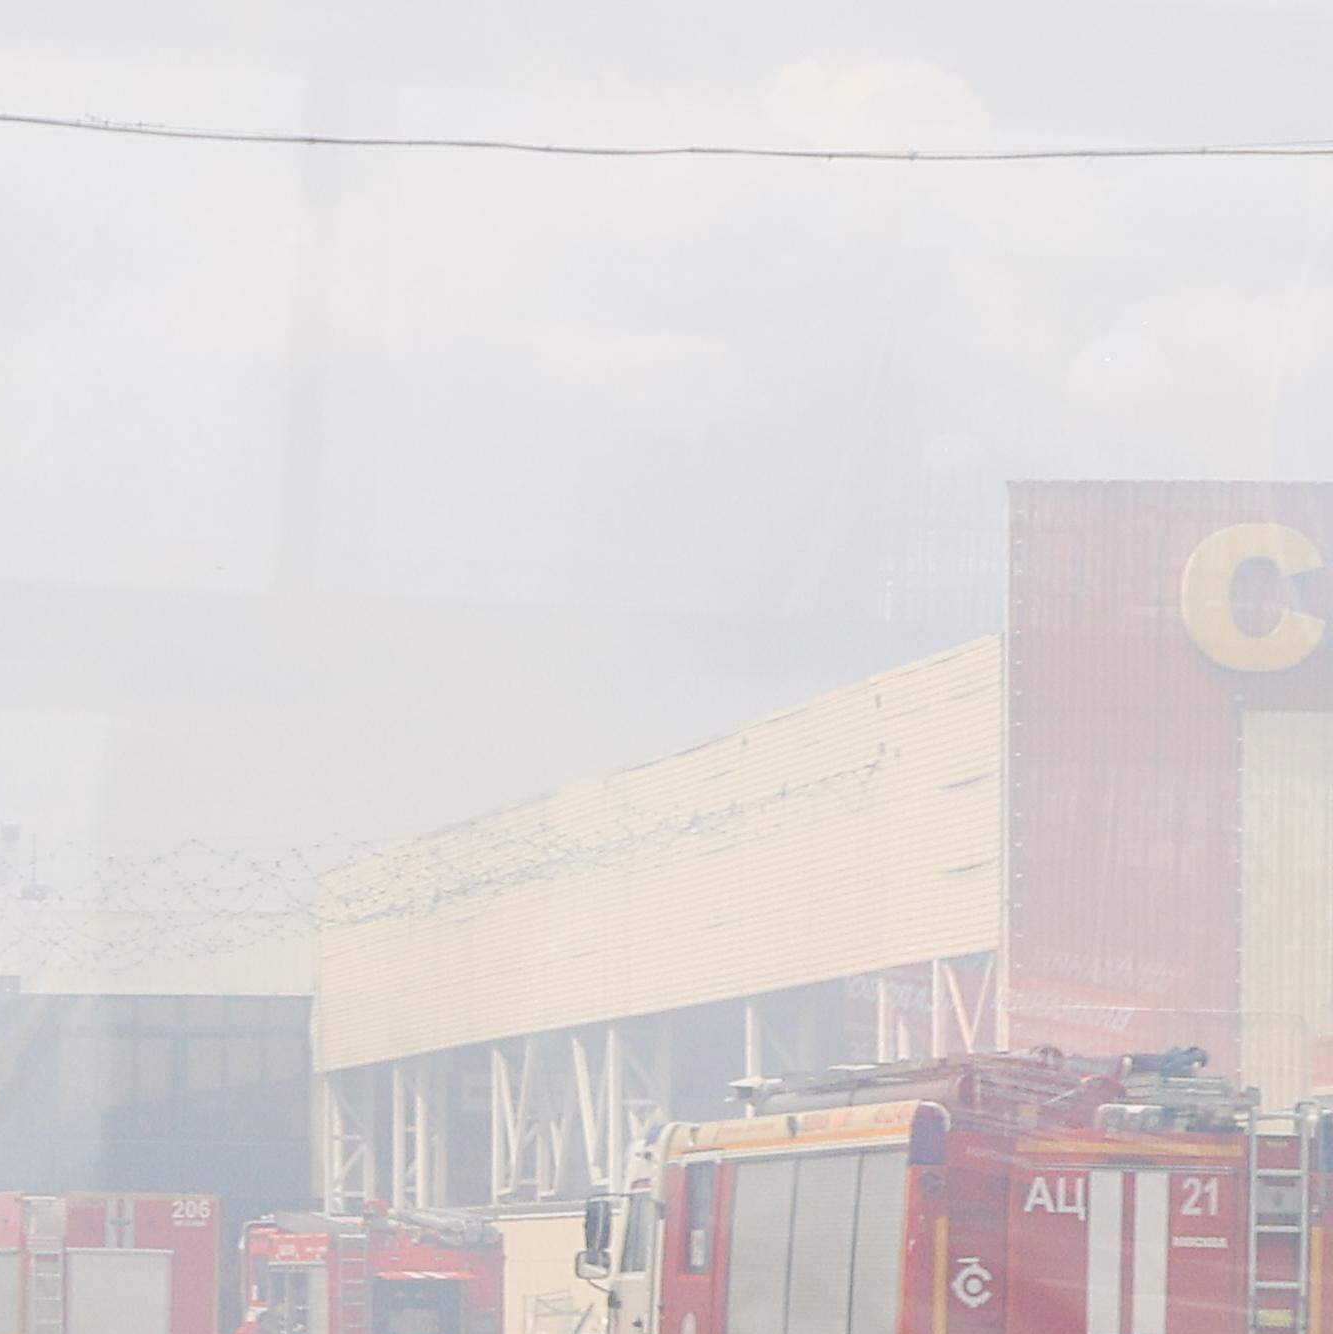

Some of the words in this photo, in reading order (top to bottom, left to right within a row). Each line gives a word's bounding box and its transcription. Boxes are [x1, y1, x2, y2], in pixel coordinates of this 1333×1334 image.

[172, 1201, 211, 1219] 206
[1024, 1176, 1086, 1221] АЦ
[1182, 1177, 1219, 1216] 21
